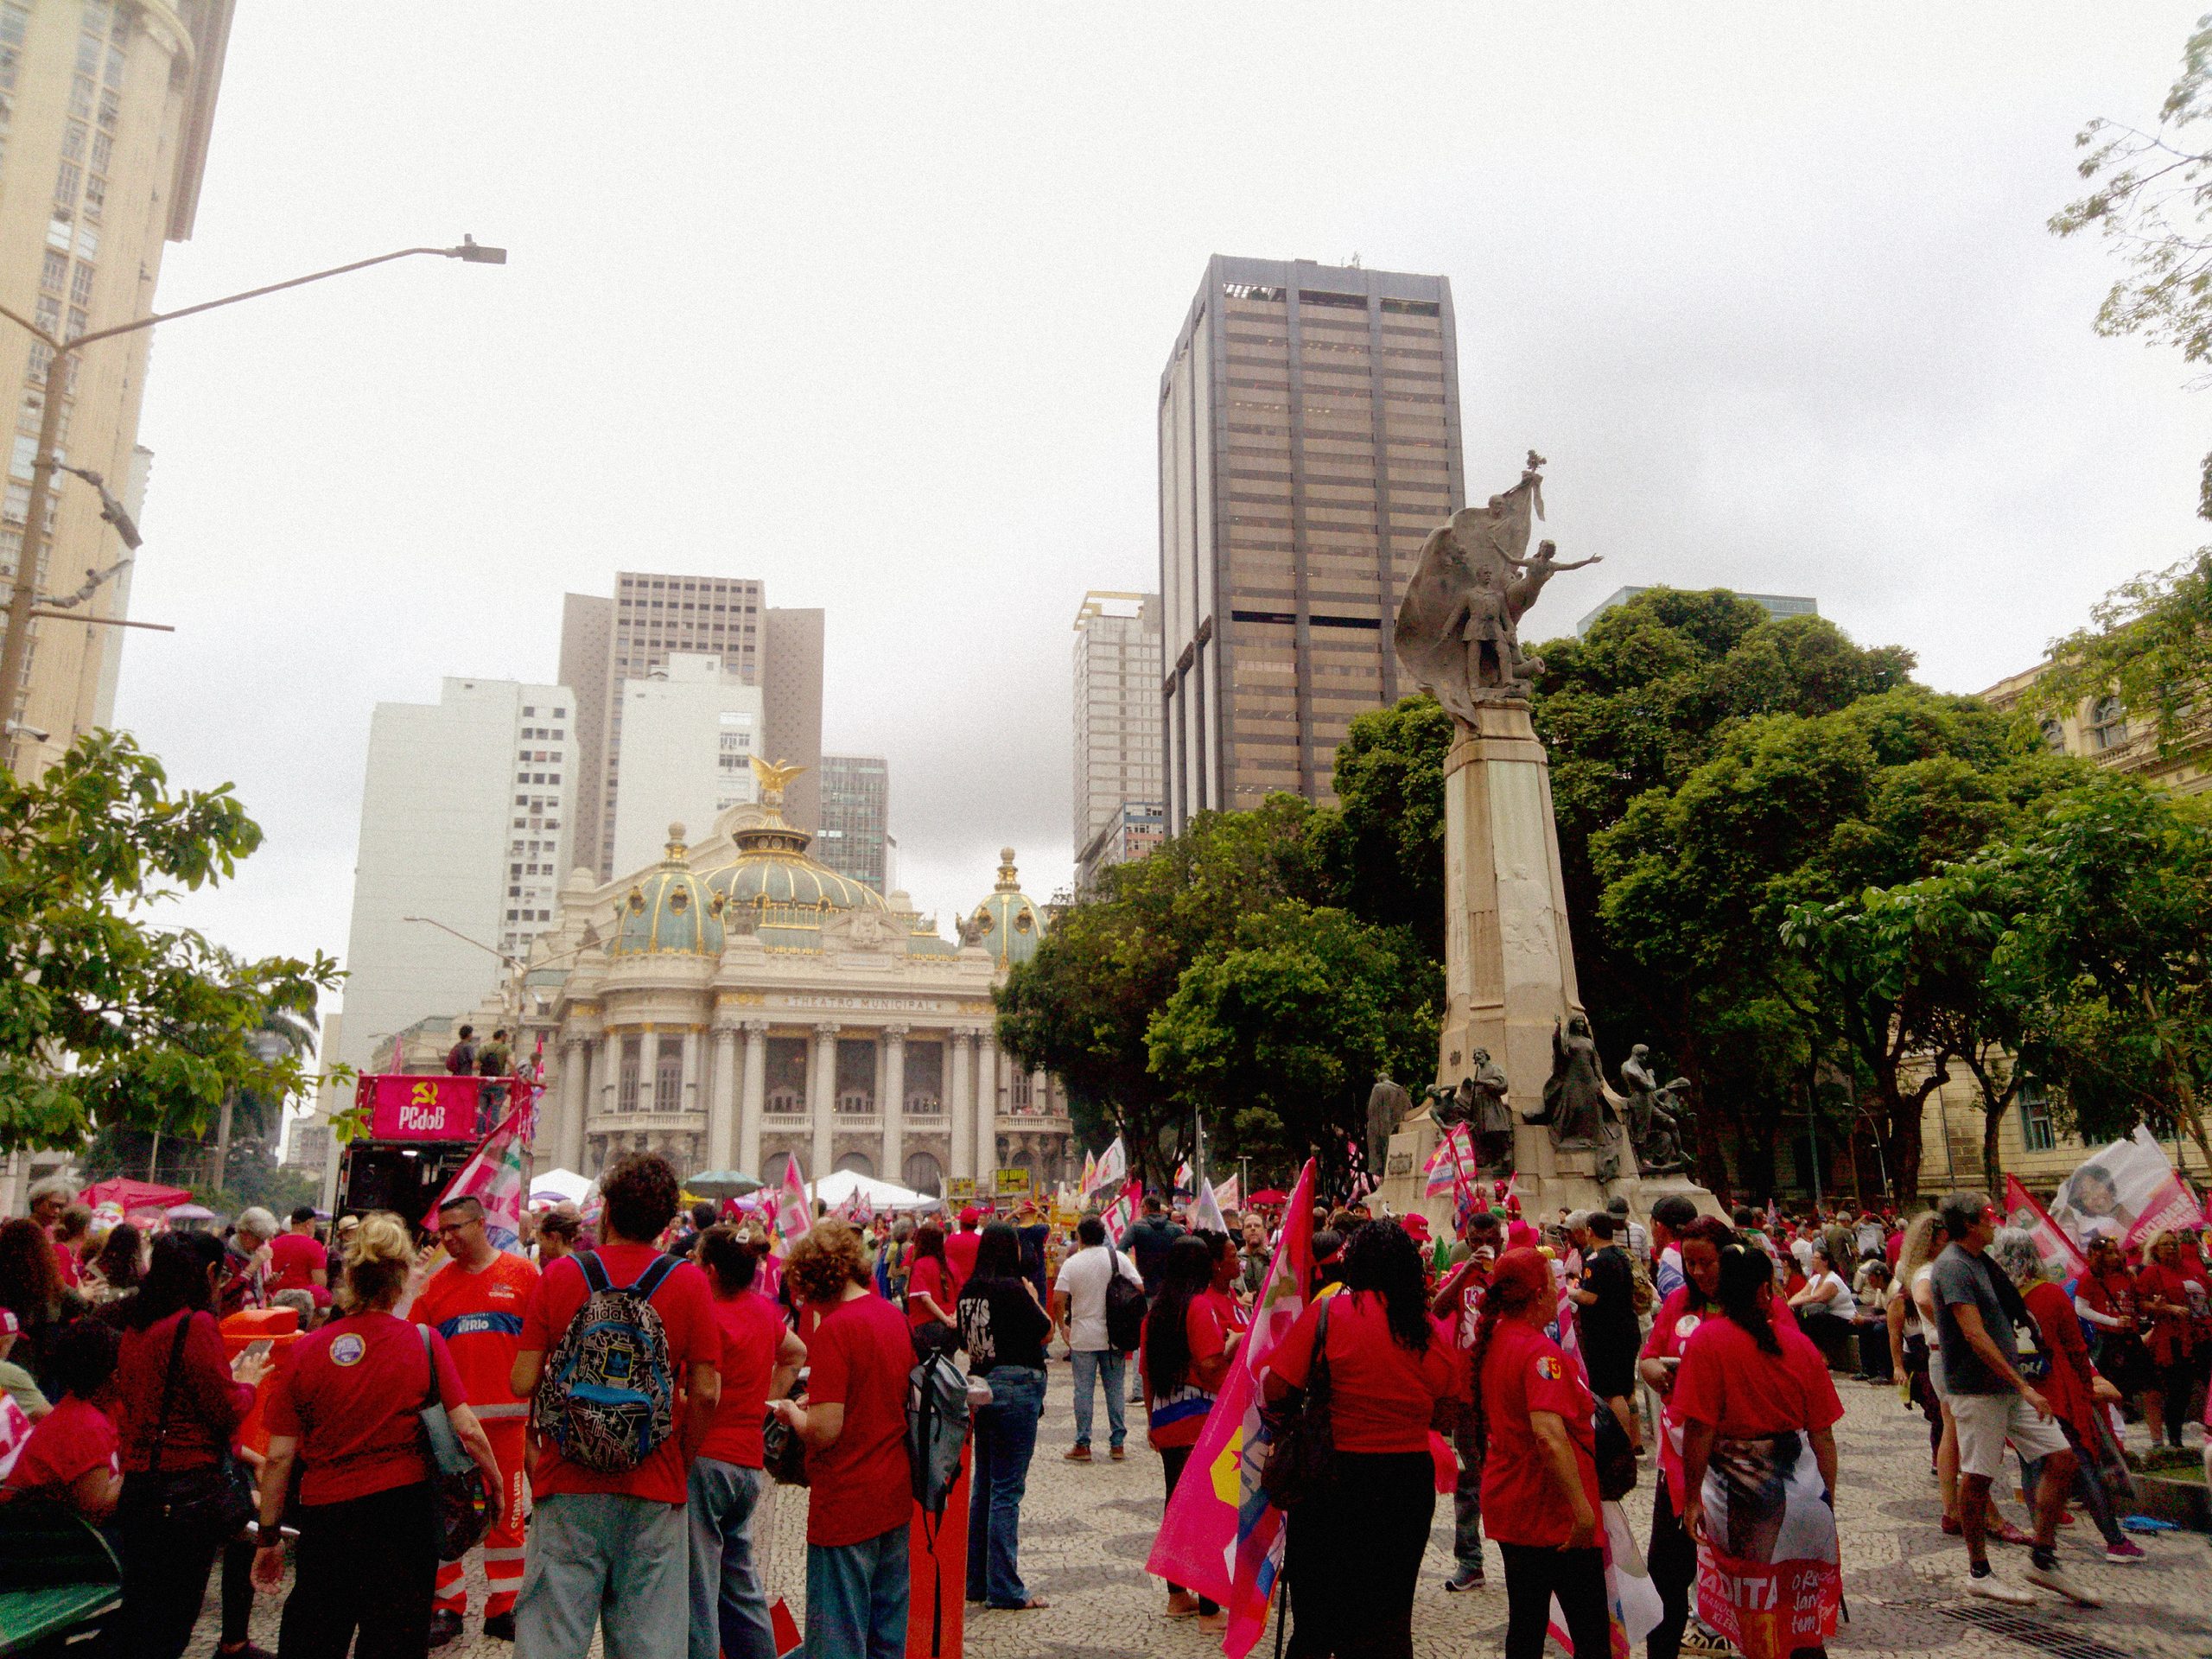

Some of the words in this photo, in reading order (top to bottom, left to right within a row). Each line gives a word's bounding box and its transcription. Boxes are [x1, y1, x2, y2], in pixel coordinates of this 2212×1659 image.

[793, 996, 855, 1008] THEATRO
[862, 998, 932, 1011] MUNICIPAL
[398, 1106, 446, 1130] PCdoB
[584, 1306, 632, 1323] adidas
